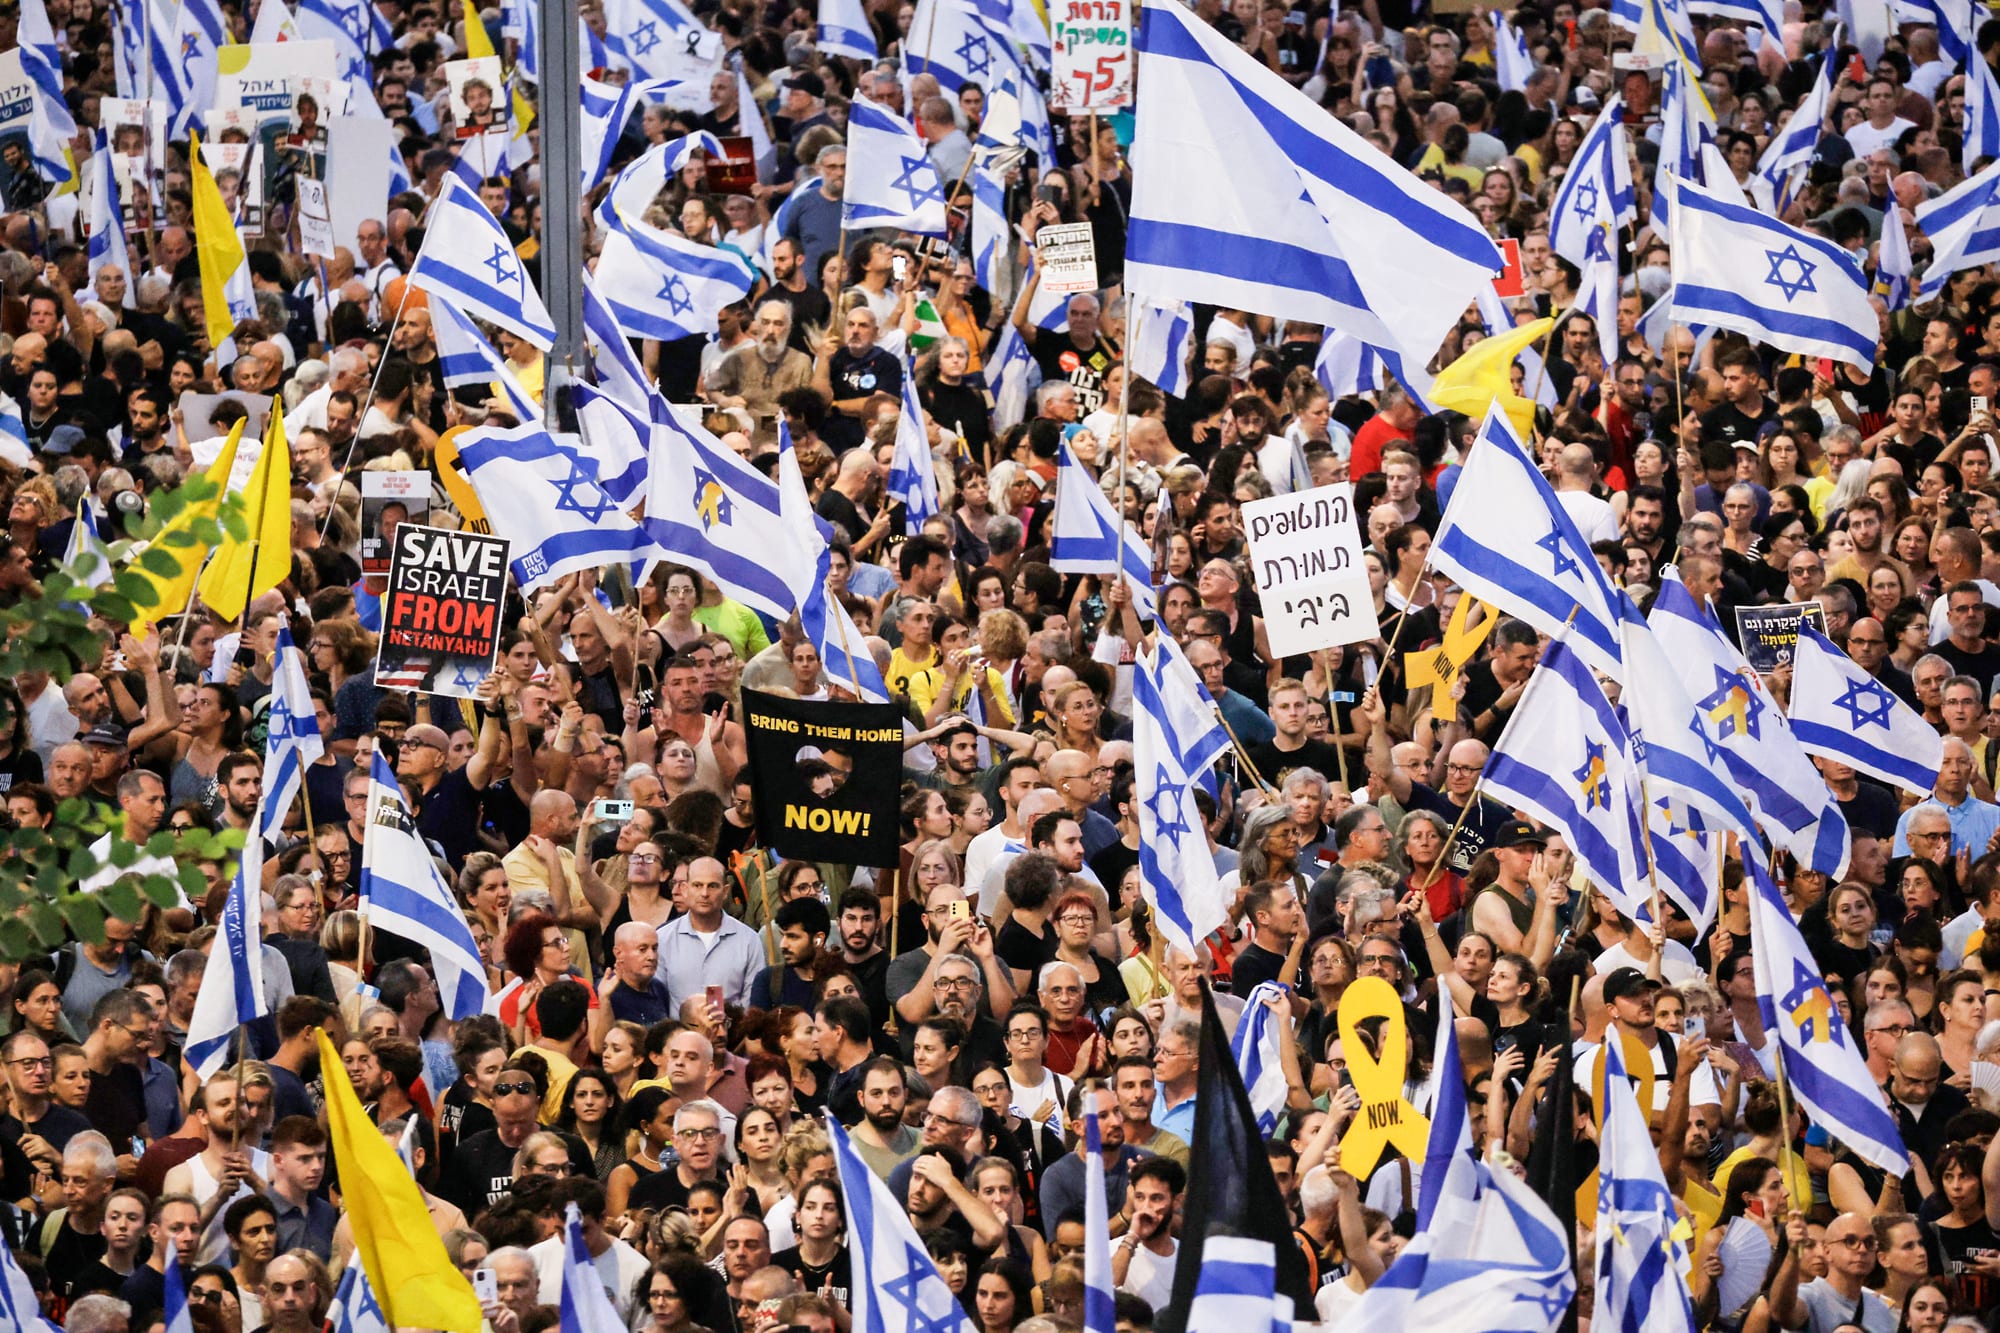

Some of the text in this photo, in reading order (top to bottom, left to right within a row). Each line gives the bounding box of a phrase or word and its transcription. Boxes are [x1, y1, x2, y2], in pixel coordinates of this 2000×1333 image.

[1066, 1, 1121, 22] הרסת
[239, 79, 274, 92] אהל
[401, 532, 503, 577] SAVE
[397, 566, 496, 602] ISRAEL
[392, 592, 495, 638] FROM
[389, 628, 490, 656] NETANYAHU
[1432, 651, 1455, 684] NOW.
[750, 713, 903, 742] BRING THEM HOME
[784, 804, 871, 837] NOW!
[1367, 1099, 1403, 1130] NOW.
